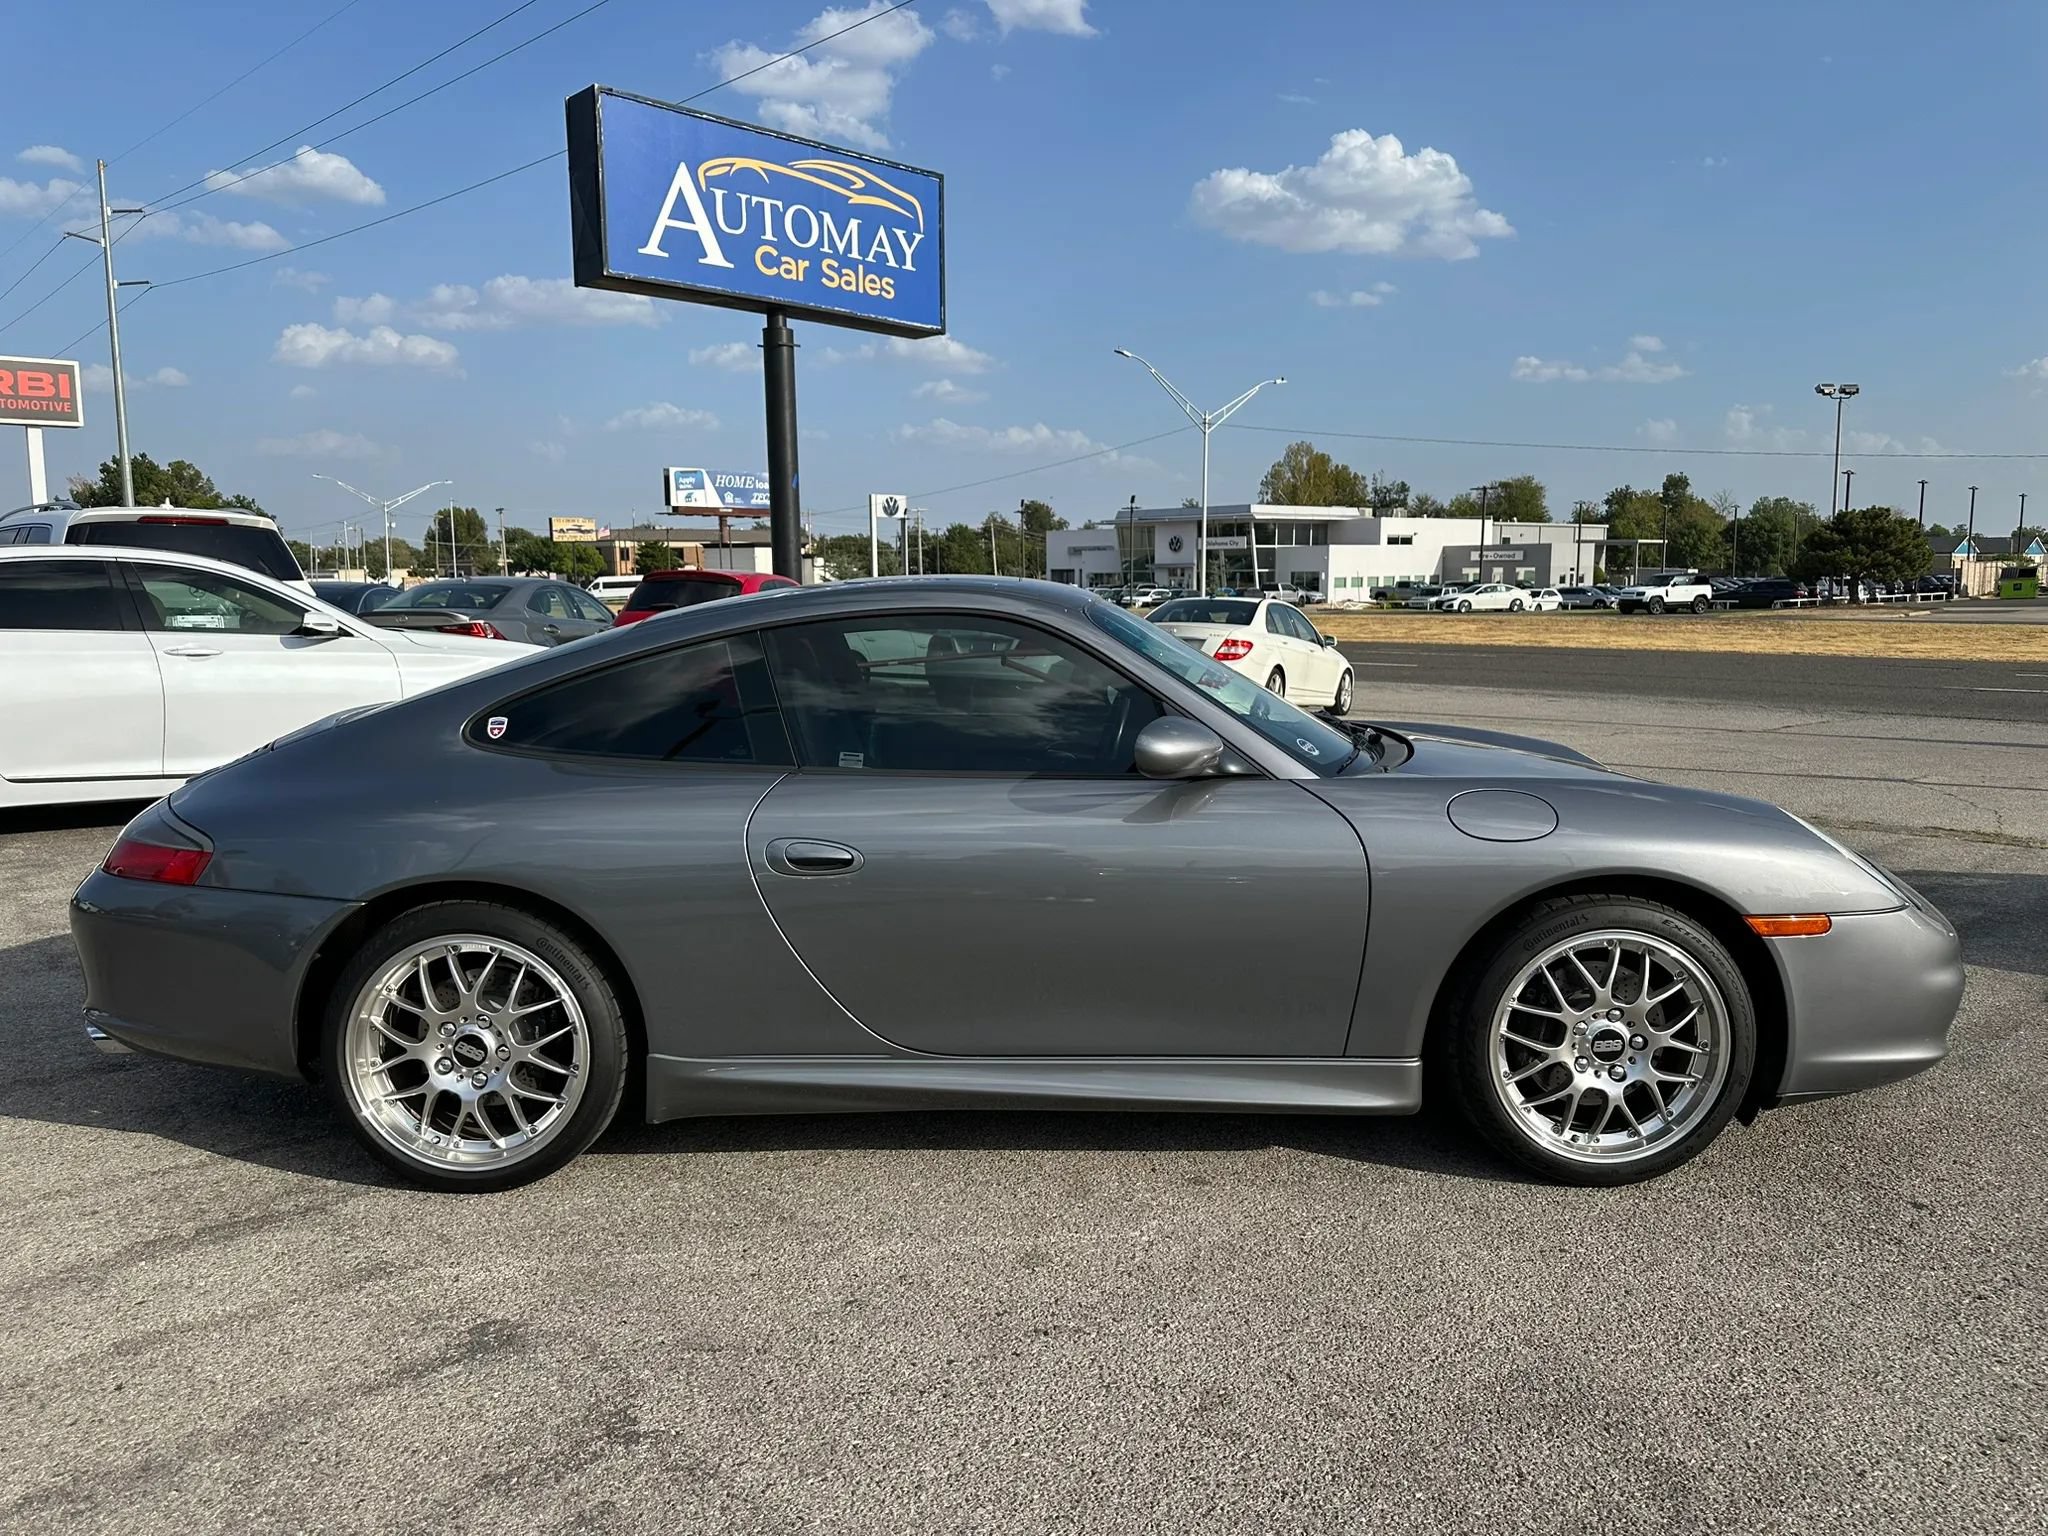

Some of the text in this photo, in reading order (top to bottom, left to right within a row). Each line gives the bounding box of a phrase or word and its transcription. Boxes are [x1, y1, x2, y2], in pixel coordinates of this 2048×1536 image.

[637, 161, 924, 271] AUTOMAY
[754, 245, 895, 300] Car Sales
[715, 475, 769, 489] HOME loa
[1523, 916, 1580, 951] Continental
[536, 937, 587, 984] Continental
[454, 1041, 486, 1062] BBS
[1592, 1039, 1624, 1053] BBS
